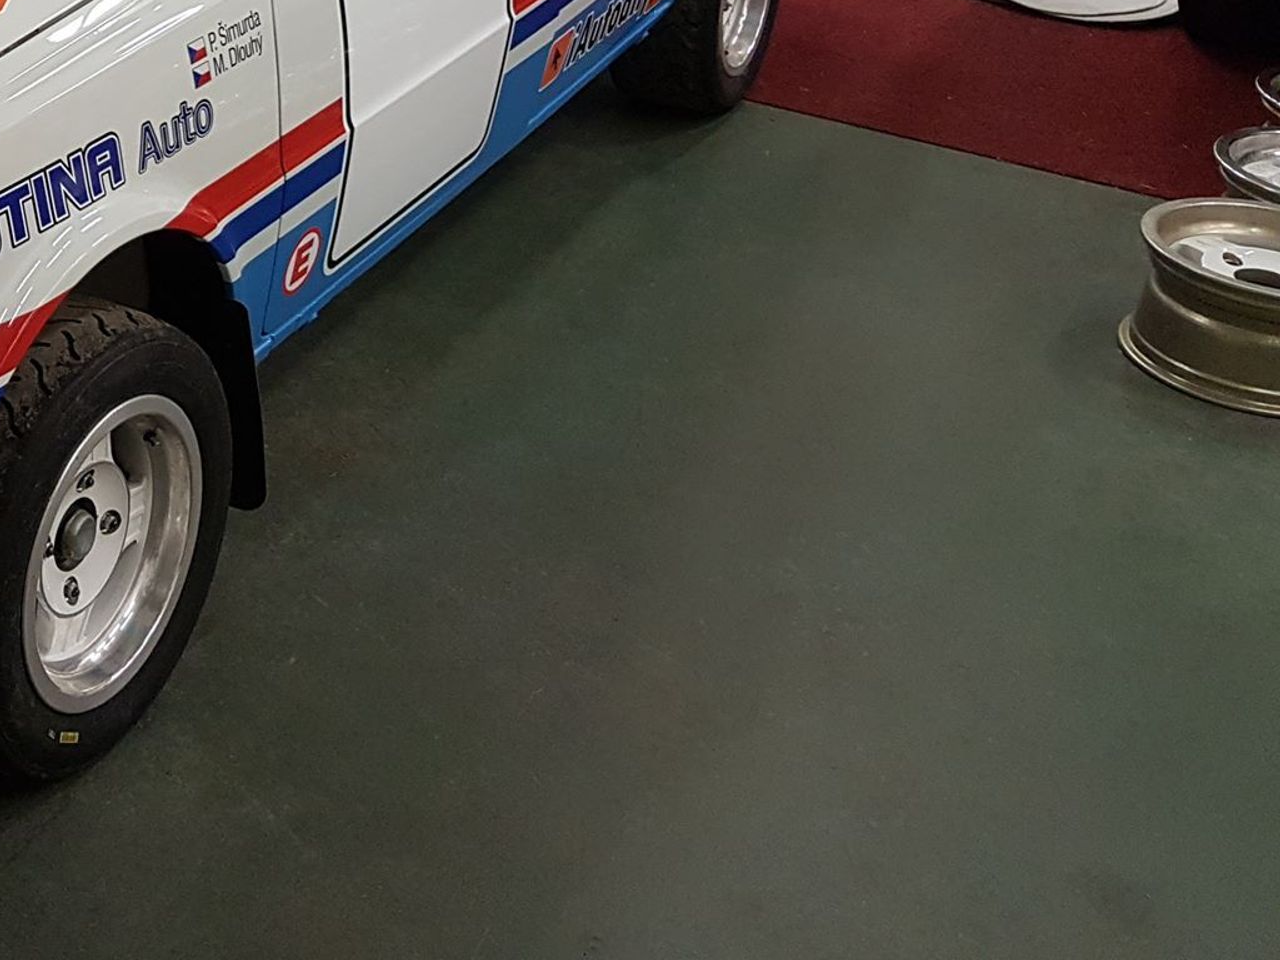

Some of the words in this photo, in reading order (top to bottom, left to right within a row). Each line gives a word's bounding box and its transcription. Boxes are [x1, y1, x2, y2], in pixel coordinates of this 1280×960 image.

[207, 31, 219, 53] P.
[217, 10, 262, 47] Šimurda
[213, 53, 229, 76] M.
[228, 31, 264, 68] Dlouhý
[137, 96, 214, 175] Auto
